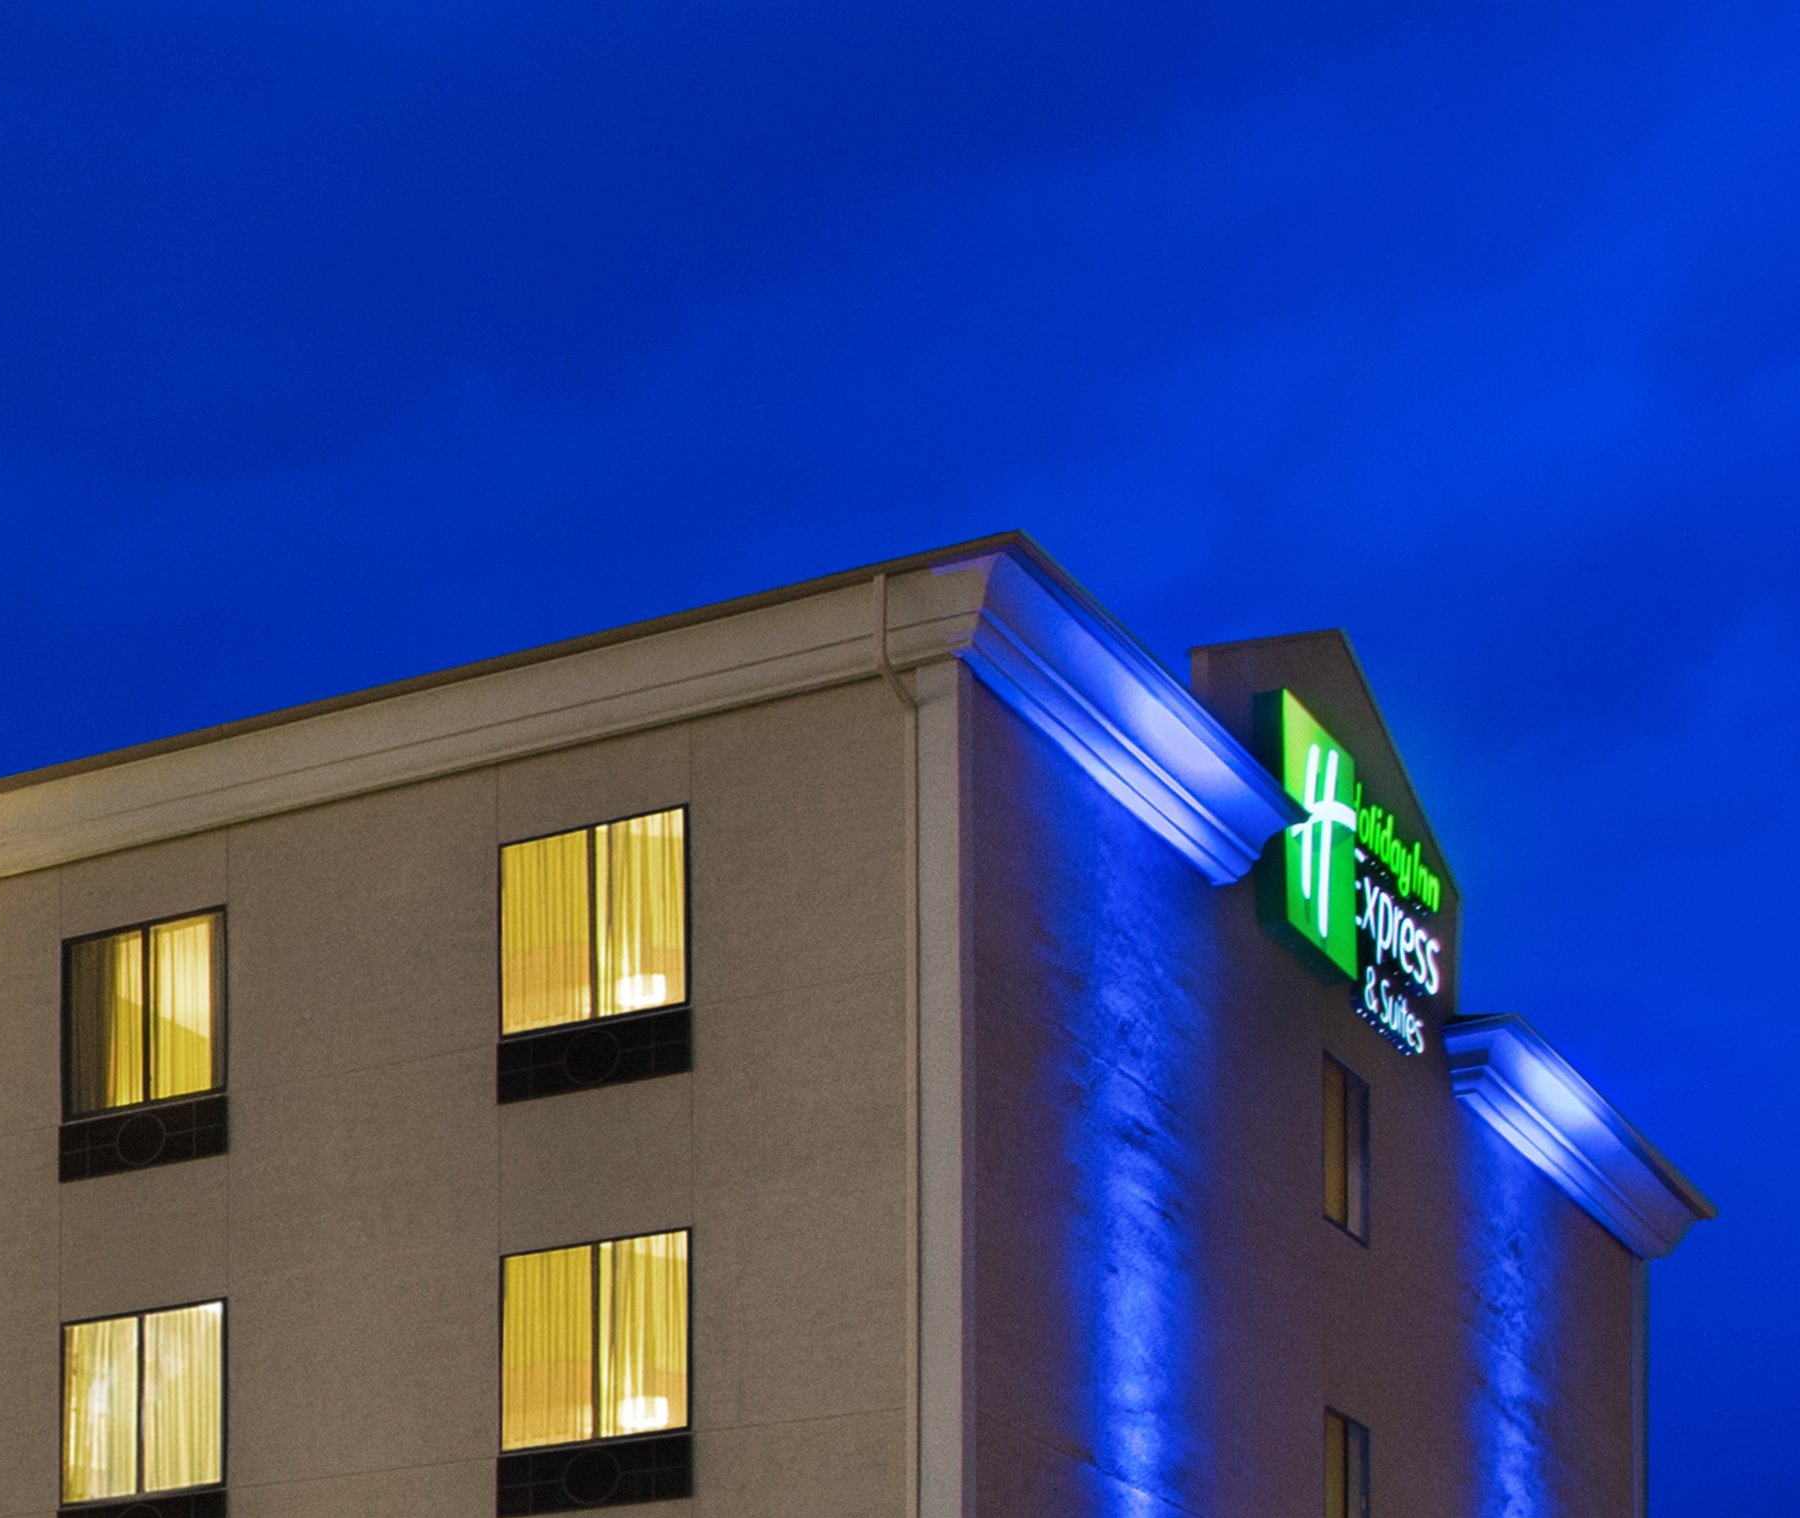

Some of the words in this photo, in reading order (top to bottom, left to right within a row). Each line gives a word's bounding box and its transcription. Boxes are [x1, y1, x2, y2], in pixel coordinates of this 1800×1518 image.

[1412, 841, 1441, 913] Inn
[1355, 849, 1441, 995] xpress
[1363, 965, 1379, 1014] &
[1379, 978, 1425, 1054] Suites
